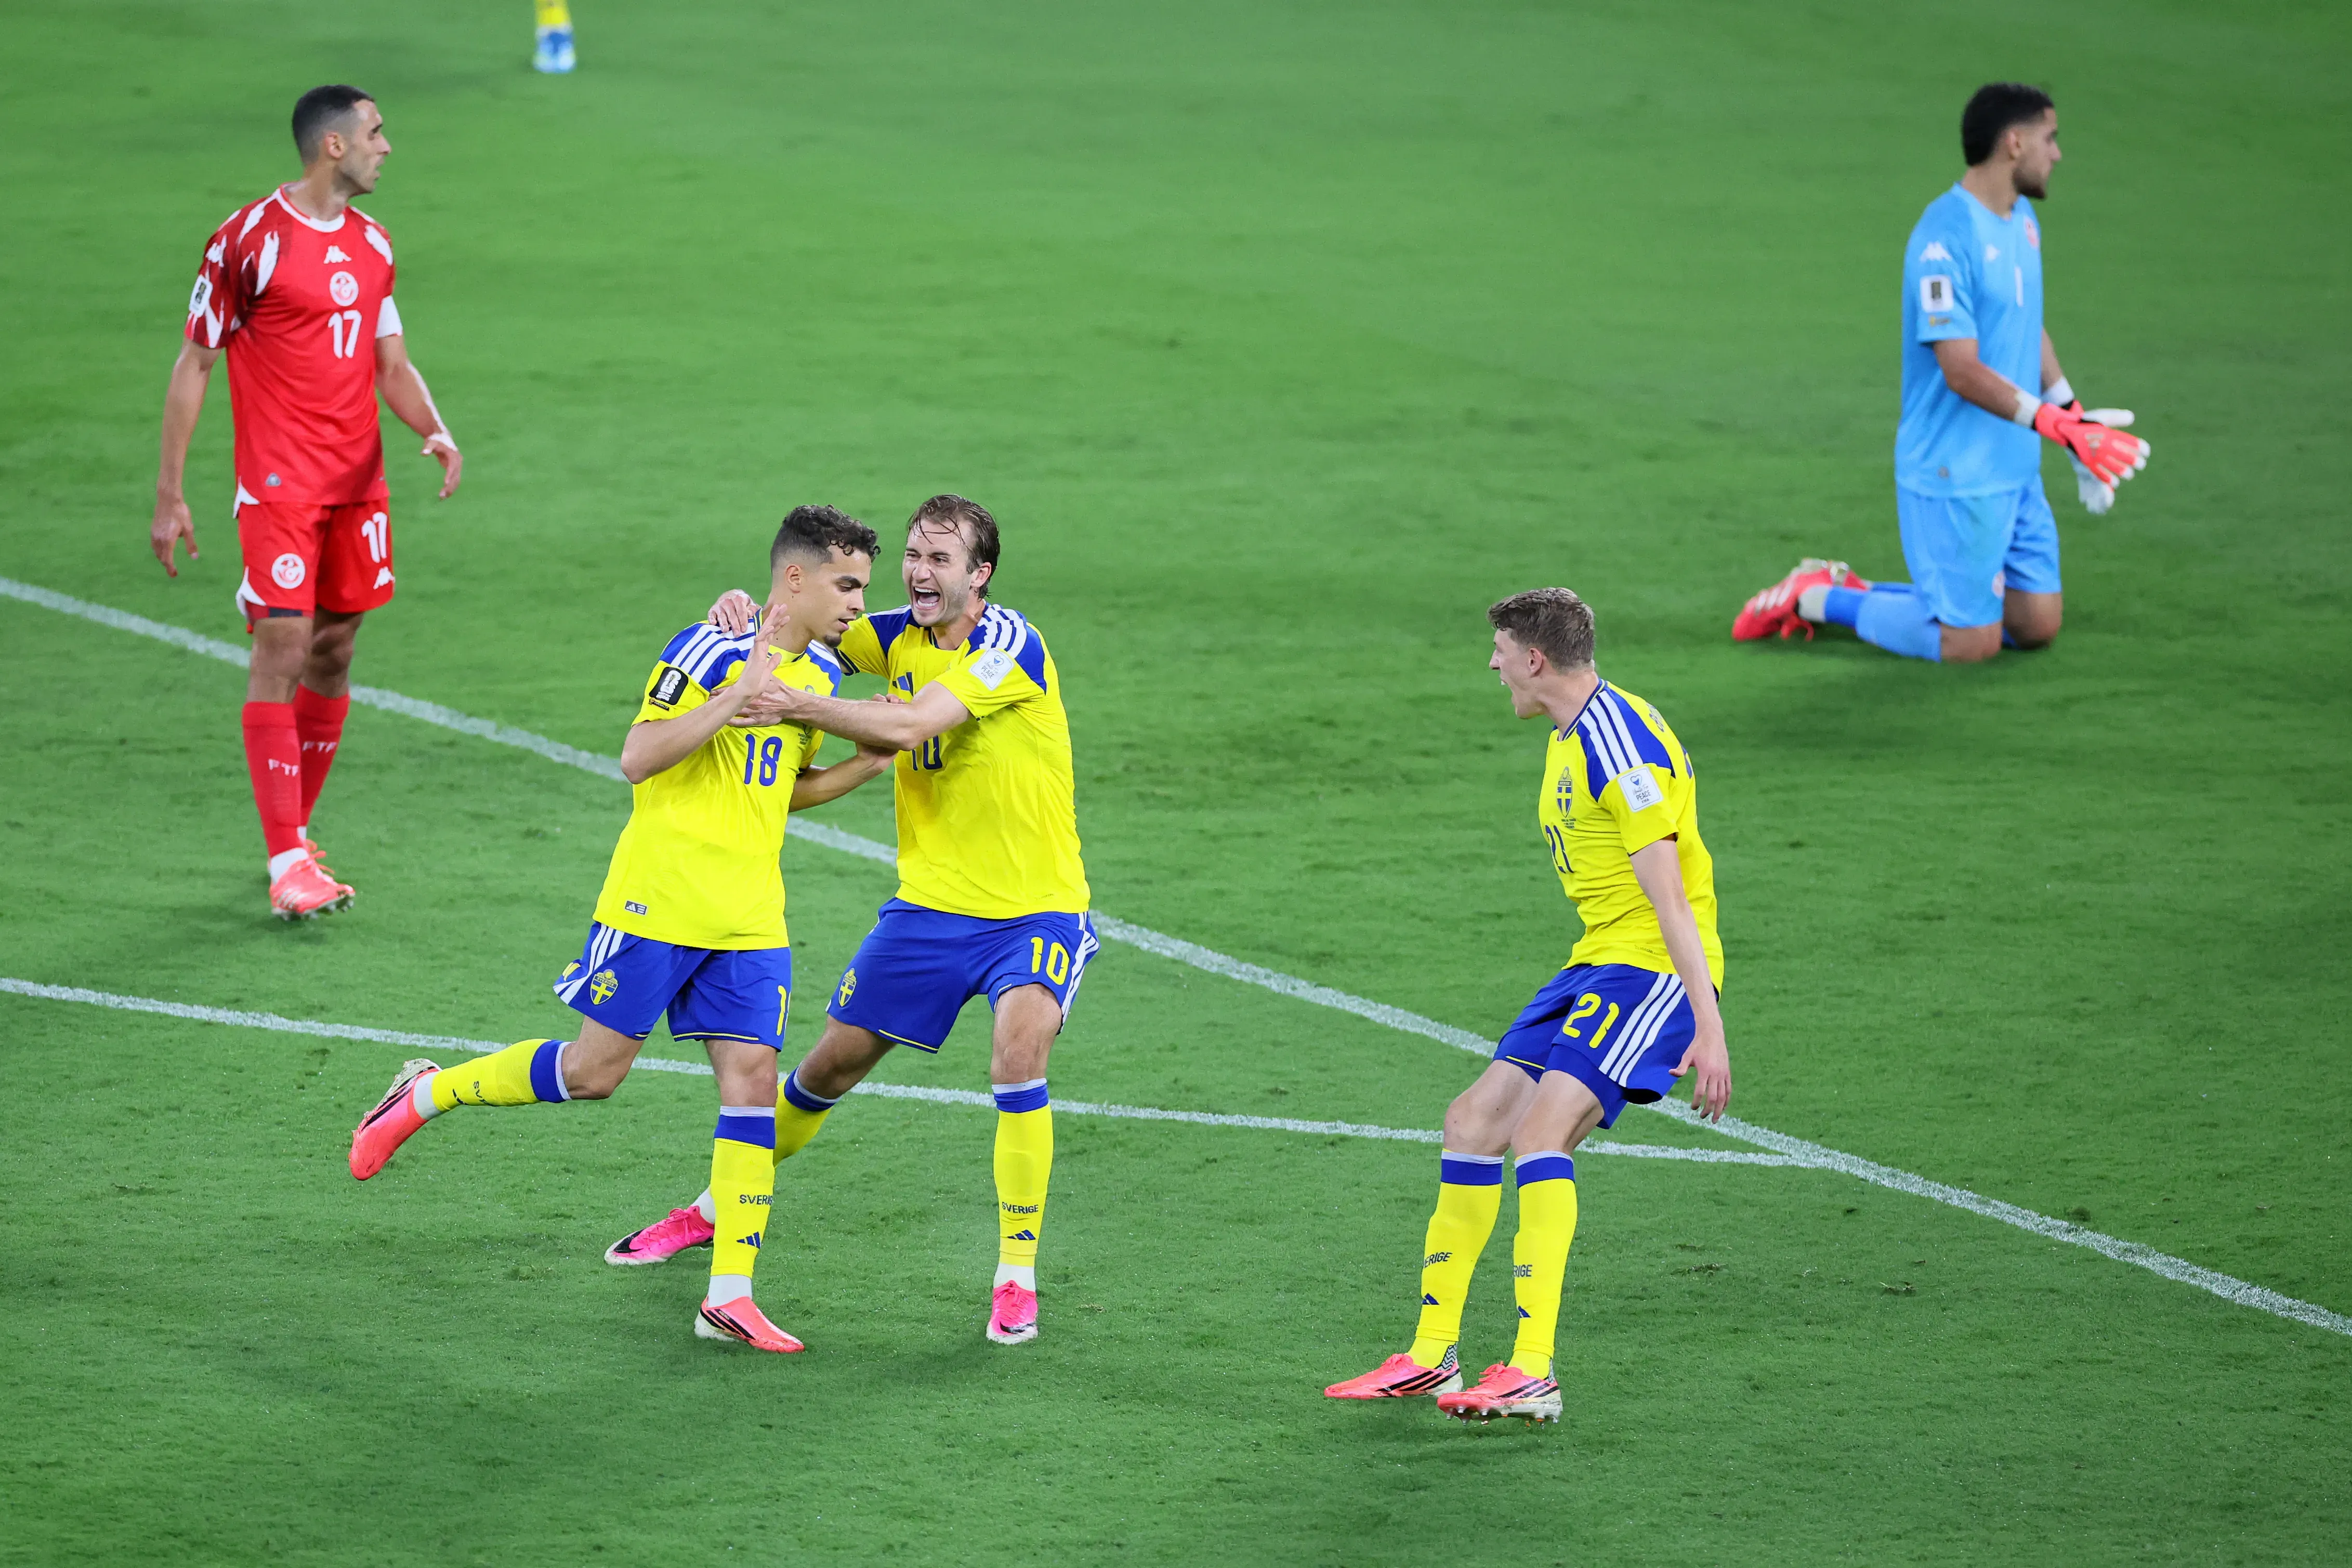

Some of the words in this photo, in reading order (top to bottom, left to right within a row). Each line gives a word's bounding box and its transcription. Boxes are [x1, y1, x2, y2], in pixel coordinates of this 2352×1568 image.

[327, 310, 362, 359] 17
[361, 511, 388, 563] 17
[981, 665, 994, 679] PEACE
[743, 734, 782, 786] 18
[1636, 790, 1651, 801] PEACE
[1030, 937, 1070, 985] 10
[777, 985, 791, 1036] 1
[1562, 993, 1620, 1049] 21
[739, 1194, 773, 1205] SVERIG
[1002, 1201, 1039, 1214] SVERIGE
[1424, 1251, 1453, 1268] ERIGE
[1513, 1264, 1533, 1277] RIGE
